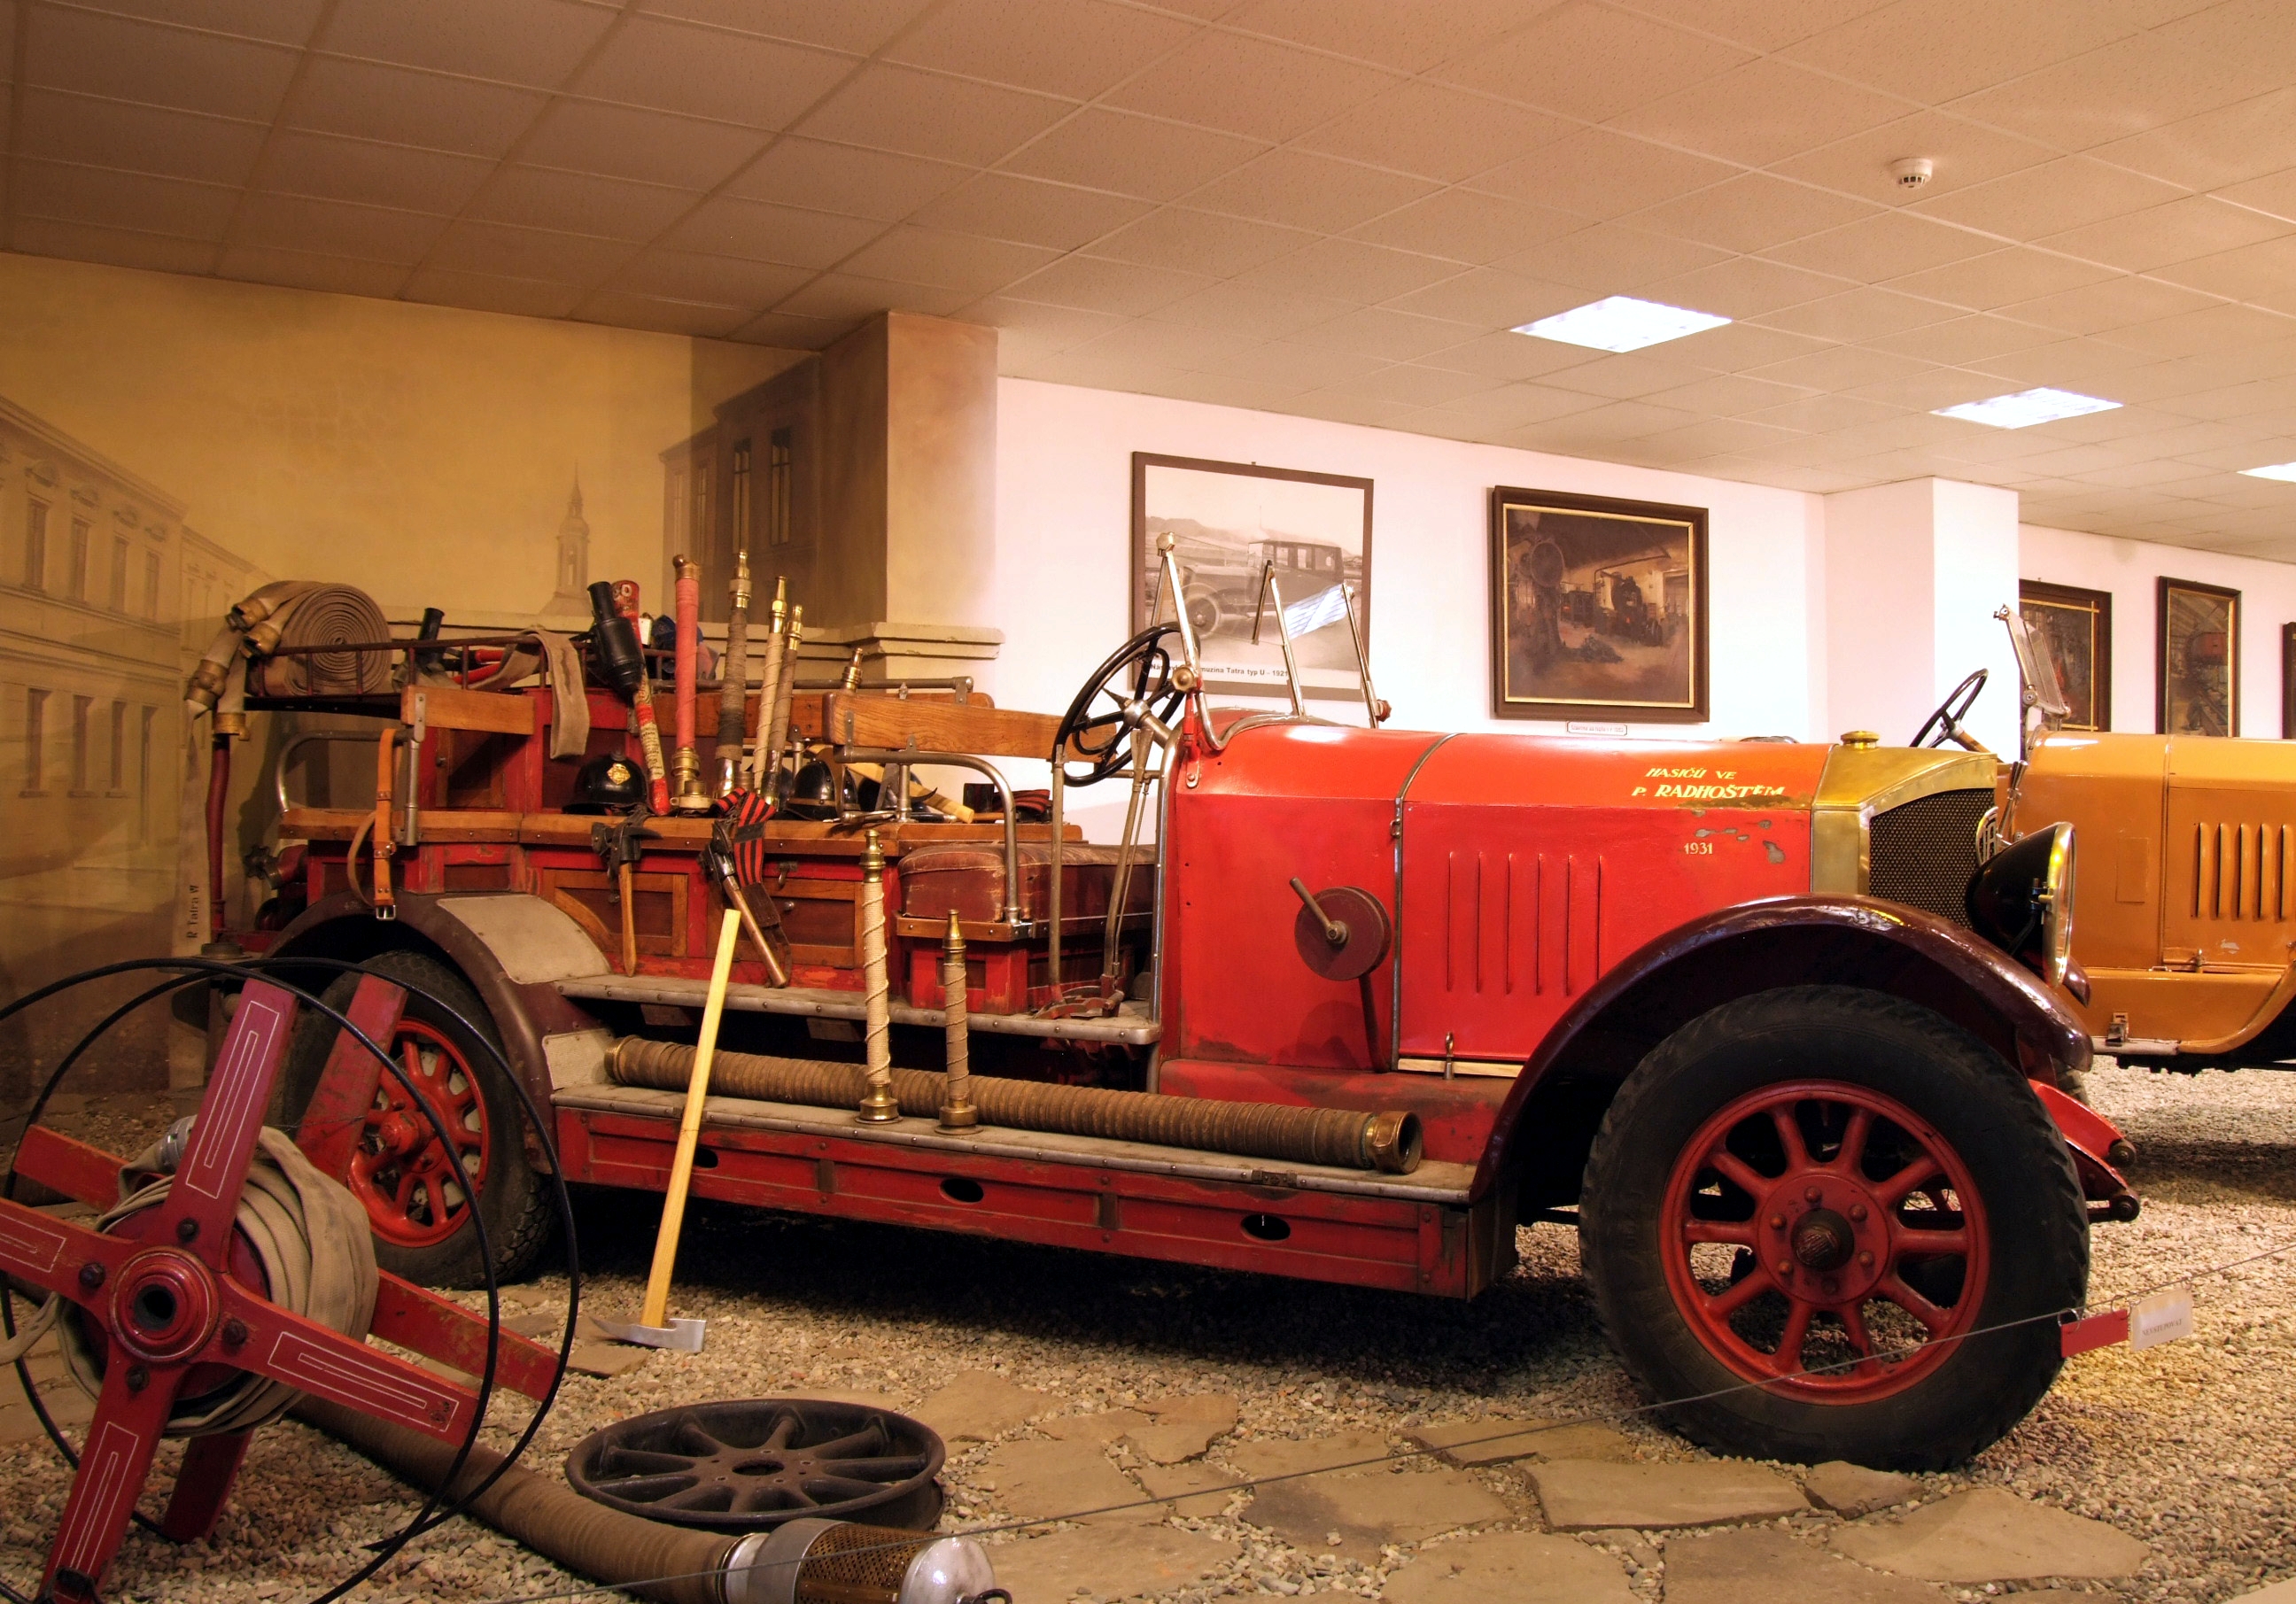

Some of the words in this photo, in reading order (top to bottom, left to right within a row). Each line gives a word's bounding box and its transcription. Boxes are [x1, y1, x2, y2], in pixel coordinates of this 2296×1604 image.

[1715, 771, 1737, 779] VE
[1631, 787, 1648, 796] P.
[1684, 842, 1714, 855] 1931
